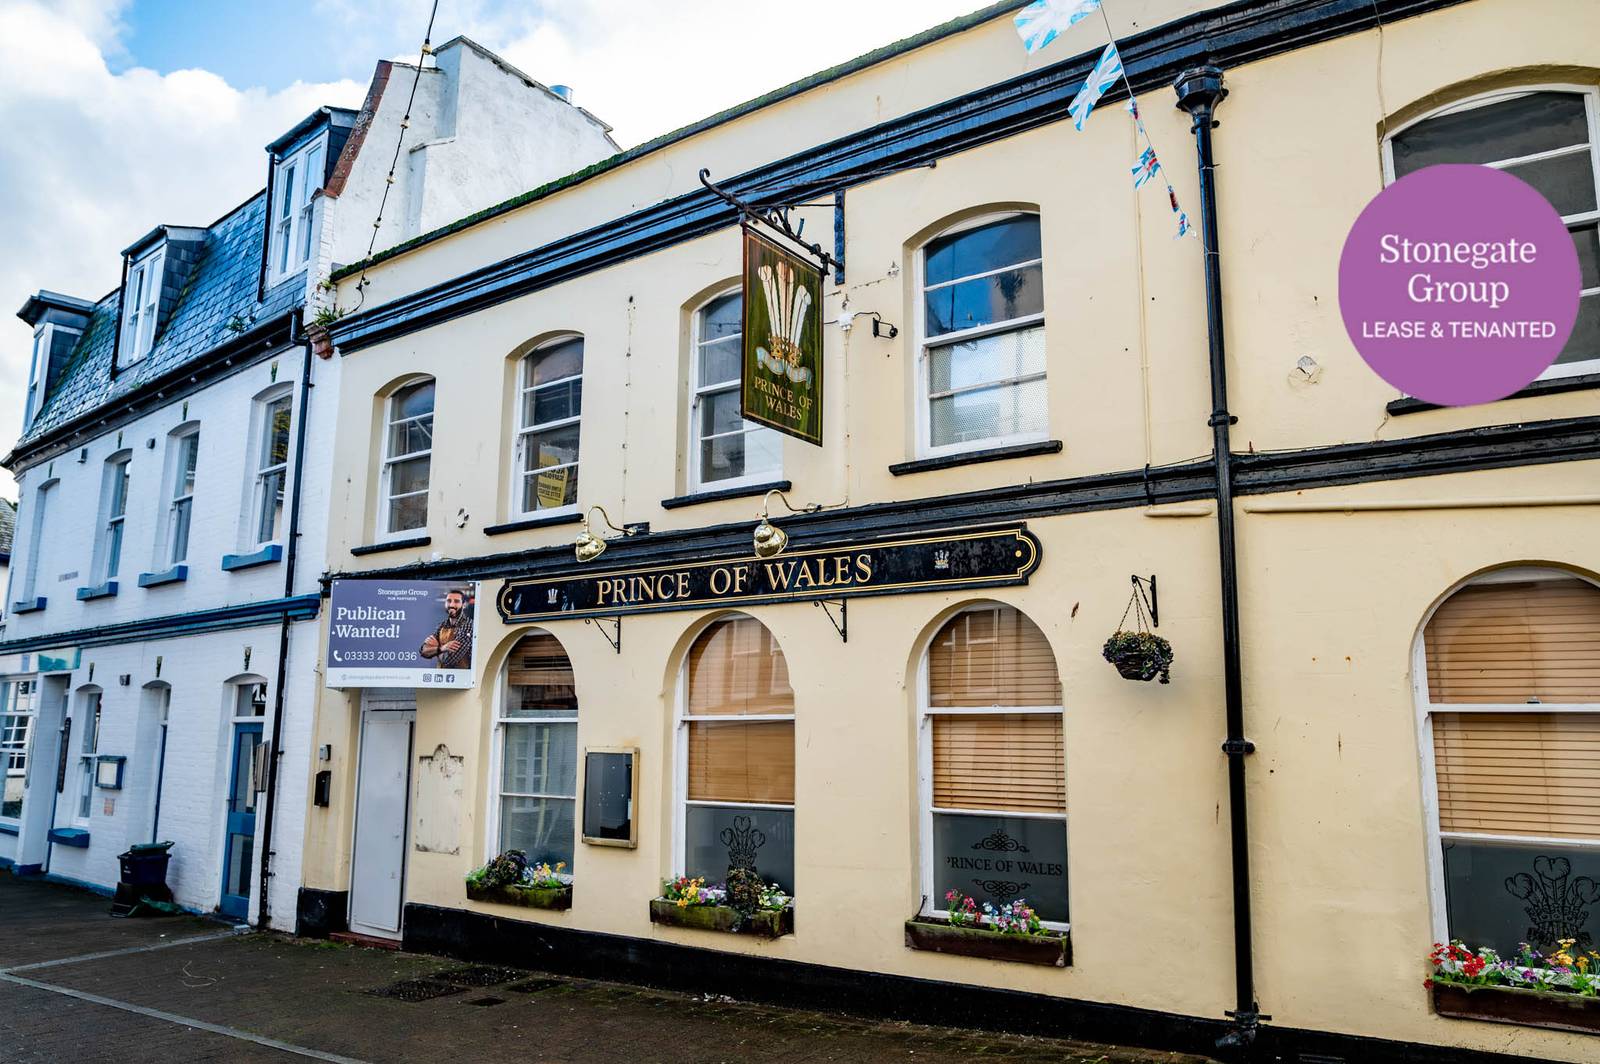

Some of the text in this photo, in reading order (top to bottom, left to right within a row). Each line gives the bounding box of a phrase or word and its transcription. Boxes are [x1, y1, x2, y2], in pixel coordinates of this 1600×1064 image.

[754, 376, 813, 409] PRINCE OF
[765, 395, 802, 420] WALES
[596, 554, 872, 605] PRINCE OF WALES
[377, 588, 429, 597] Stonegate Group
[336, 606, 406, 621] Publican
[335, 624, 401, 638] Wanted!
[344, 651, 417, 661] 03333 200 036
[995, 860, 1014, 873] OF
[1016, 861, 1063, 876] WALES
